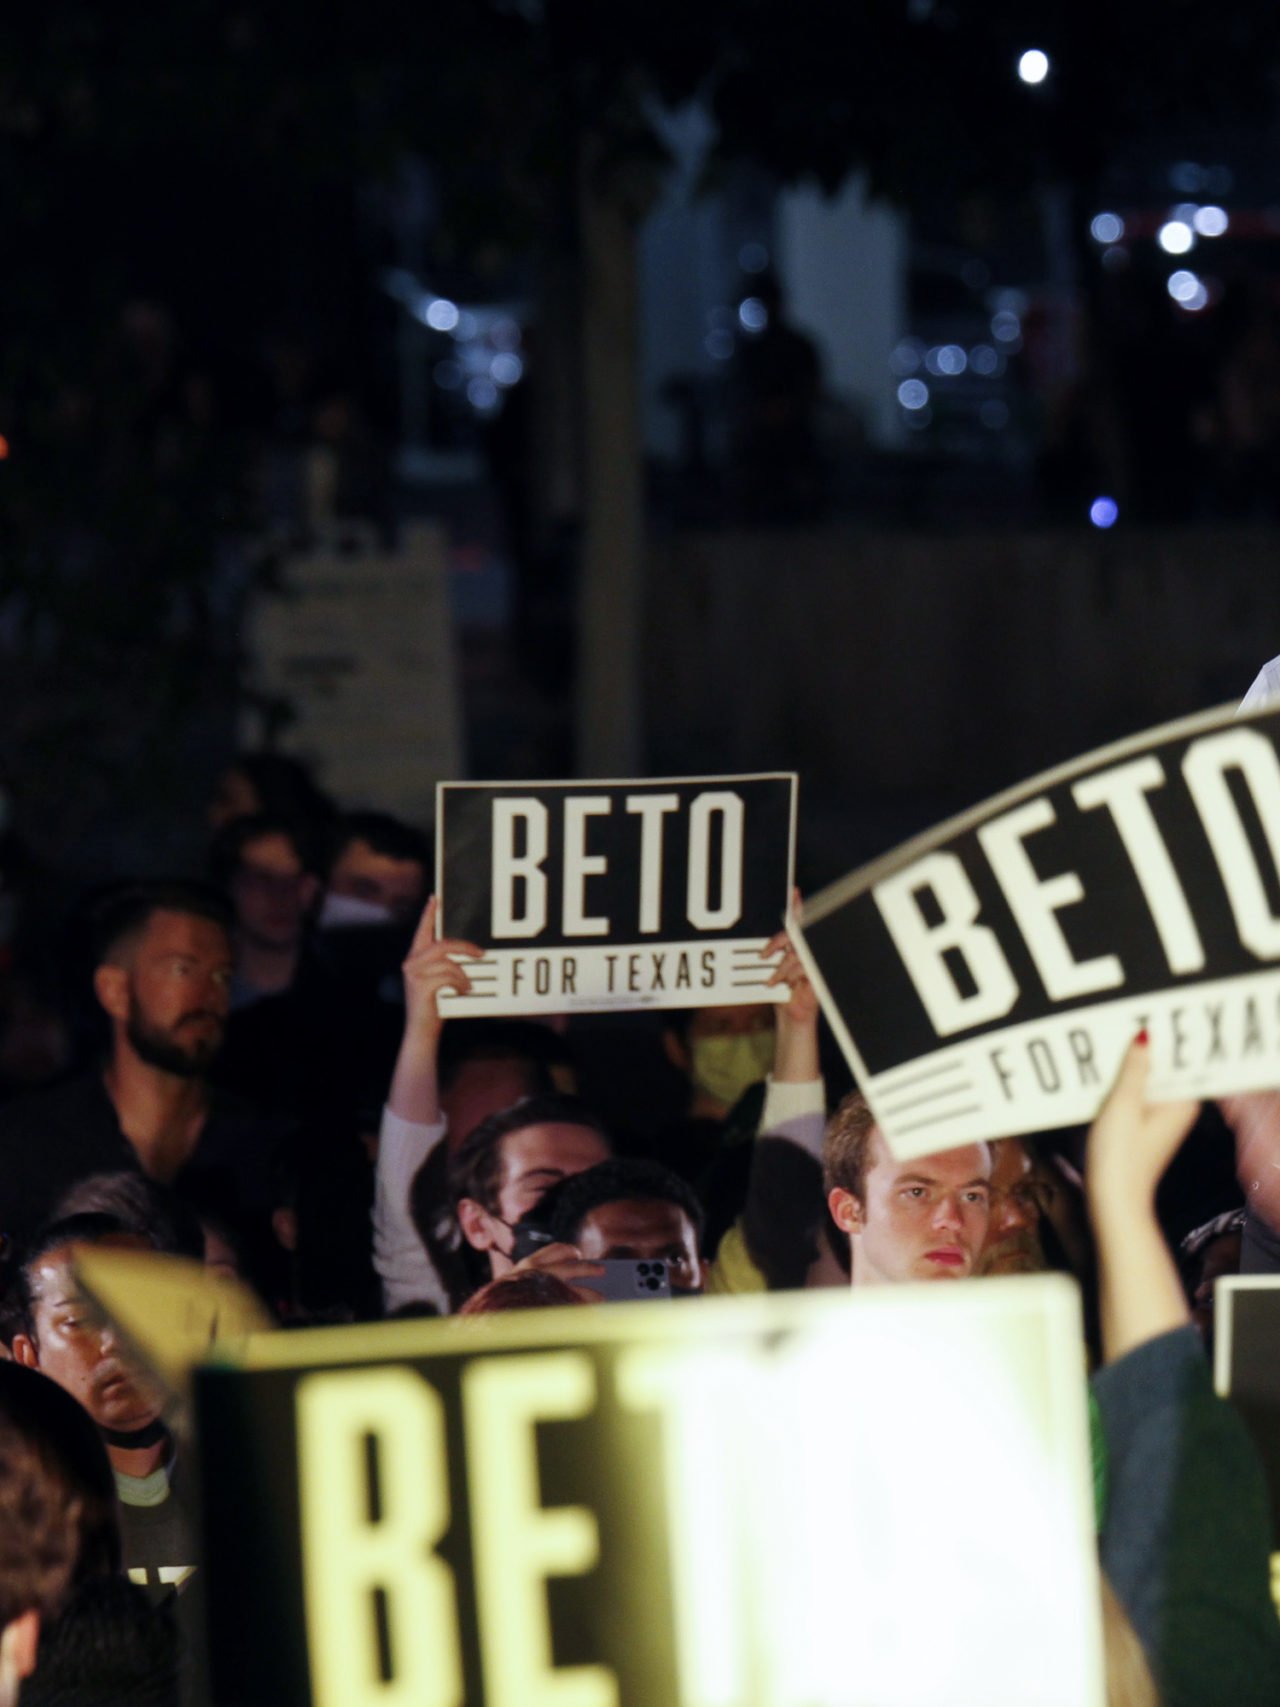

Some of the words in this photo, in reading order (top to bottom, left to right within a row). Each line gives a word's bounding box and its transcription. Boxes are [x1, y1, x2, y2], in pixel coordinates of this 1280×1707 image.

[491, 791, 744, 939] BETO
[512, 957, 577, 996] FOR
[605, 950, 716, 992] TEXAS
[989, 1032, 1100, 1101] FOR
